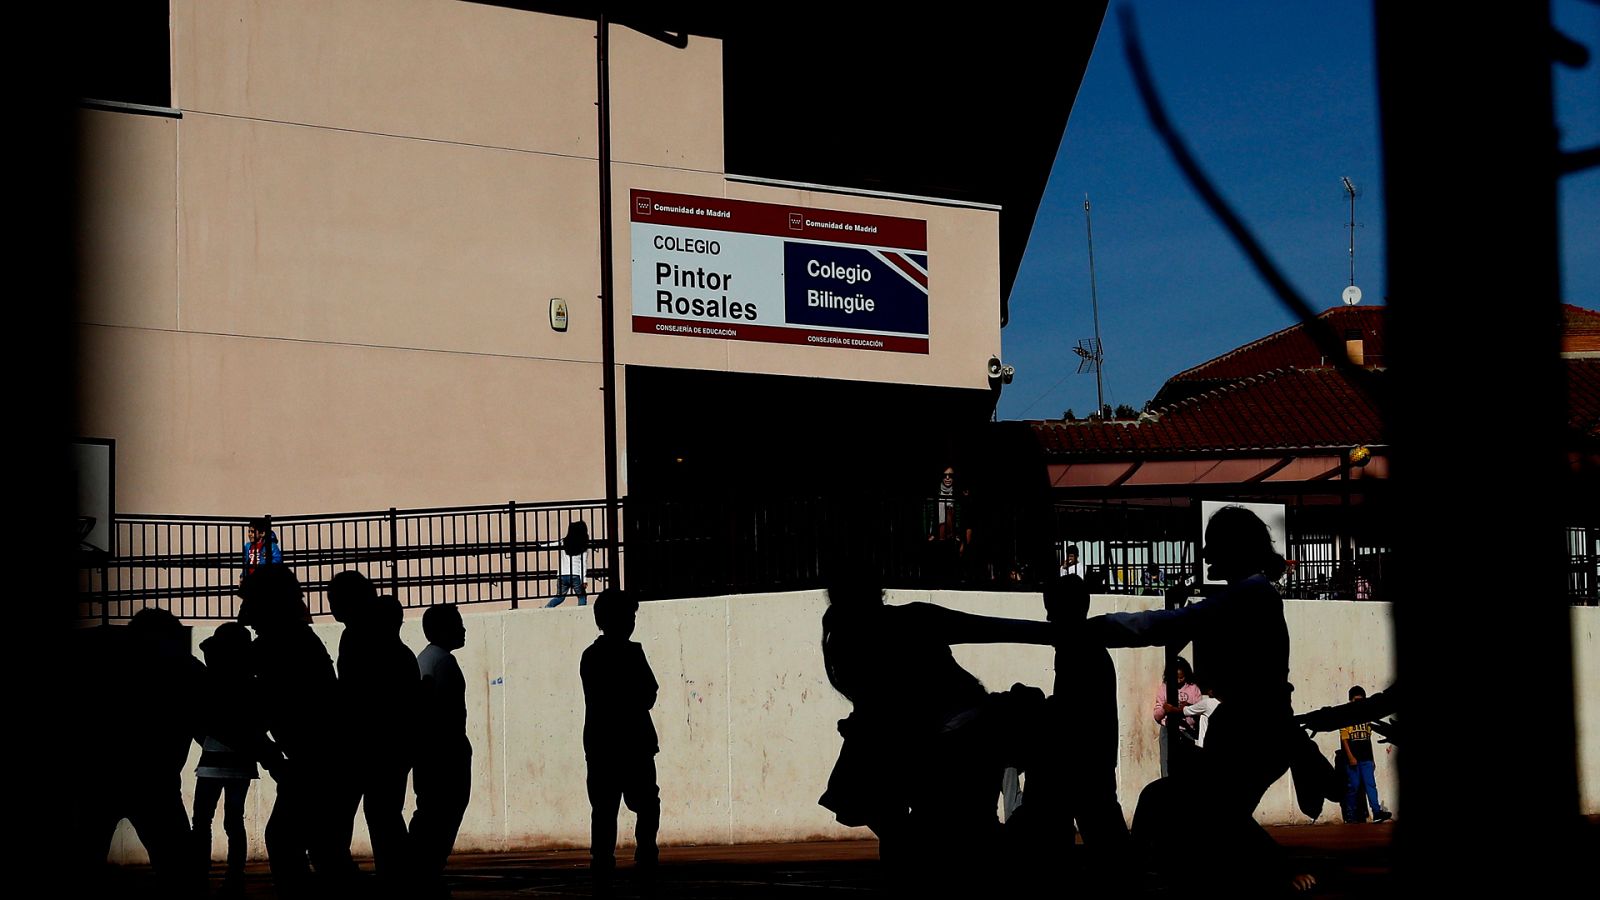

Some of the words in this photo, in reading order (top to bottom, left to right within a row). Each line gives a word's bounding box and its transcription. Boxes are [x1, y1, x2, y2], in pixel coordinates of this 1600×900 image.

[654, 203, 694, 215] Comunidad
[696, 208, 705, 216] de
[706, 209, 731, 218] Madrid
[806, 219, 843, 230] Comunidad
[854, 224, 877, 233] Madrid
[654, 235, 720, 255] COLEGIO
[656, 262, 731, 290] Pintor
[807, 259, 871, 284] Colegio
[656, 290, 757, 320] Rosales
[807, 289, 874, 313] Bilingüe
[655, 324, 692, 334] CONSEJERÍA
[693, 326, 702, 334] DE
[702, 327, 737, 336] EDUCACIÓN
[807, 335, 842, 345] CONSEJERÍA
[851, 338, 883, 347] EDUCACIÓN
